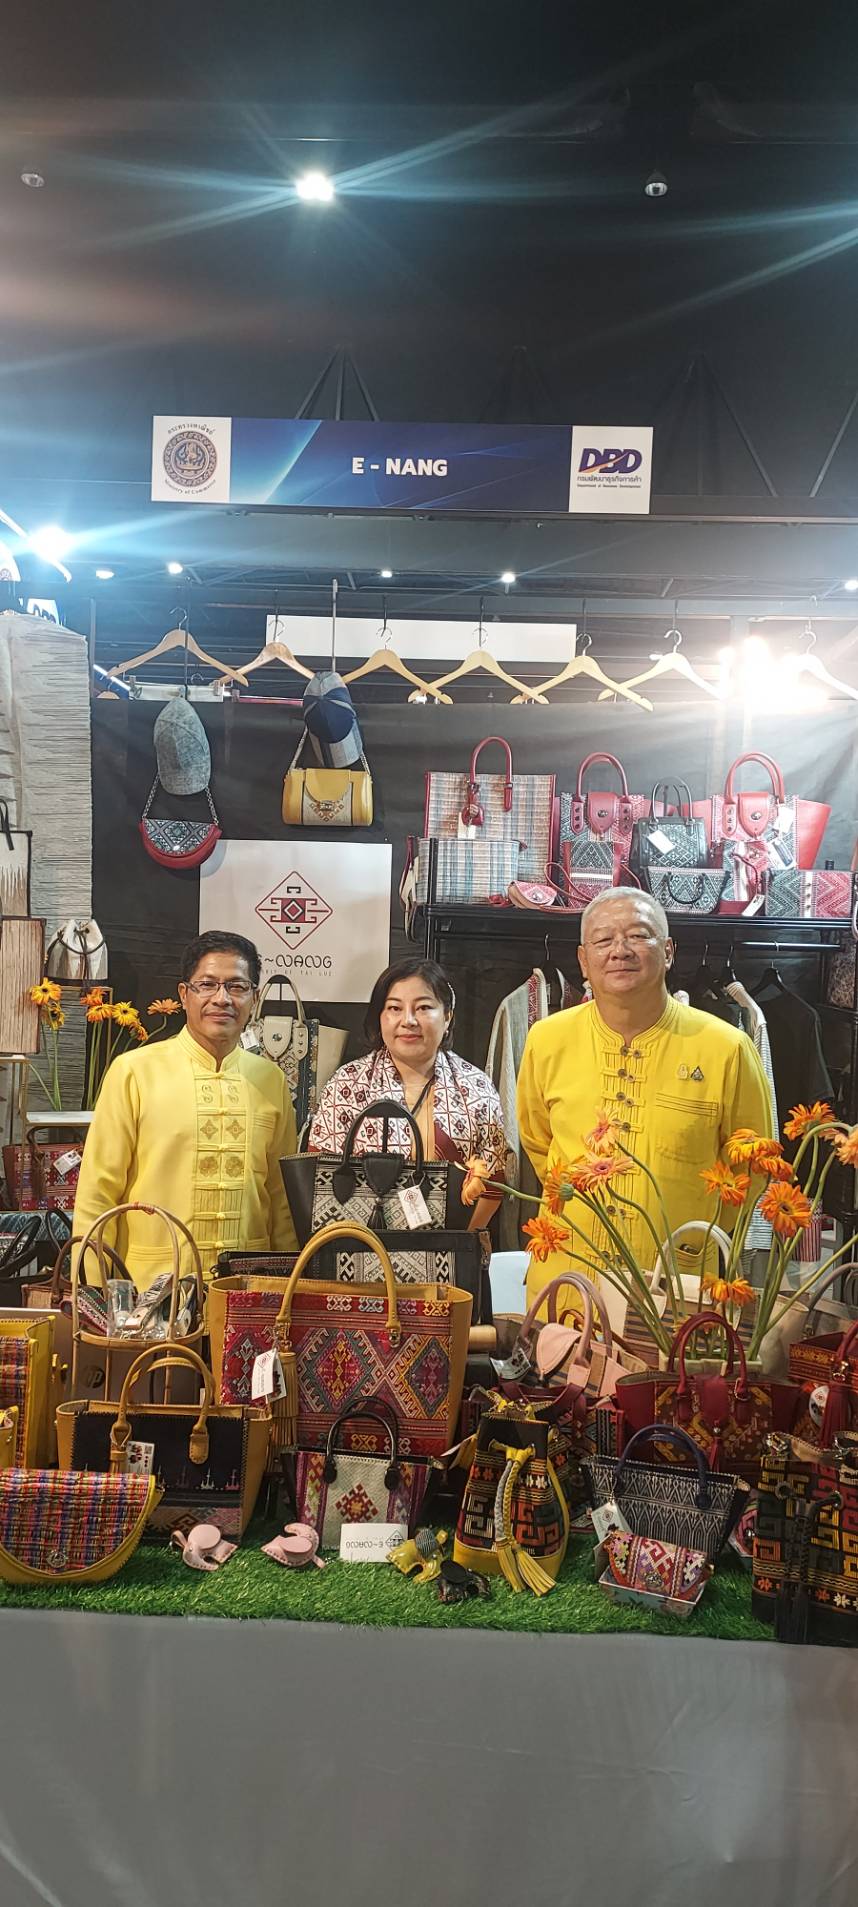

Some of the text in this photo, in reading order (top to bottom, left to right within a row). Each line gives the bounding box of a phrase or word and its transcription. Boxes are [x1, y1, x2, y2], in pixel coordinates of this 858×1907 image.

[352, 456, 364, 474] E
[385, 457, 448, 477] NANG
[578, 447, 643, 474] DBD
